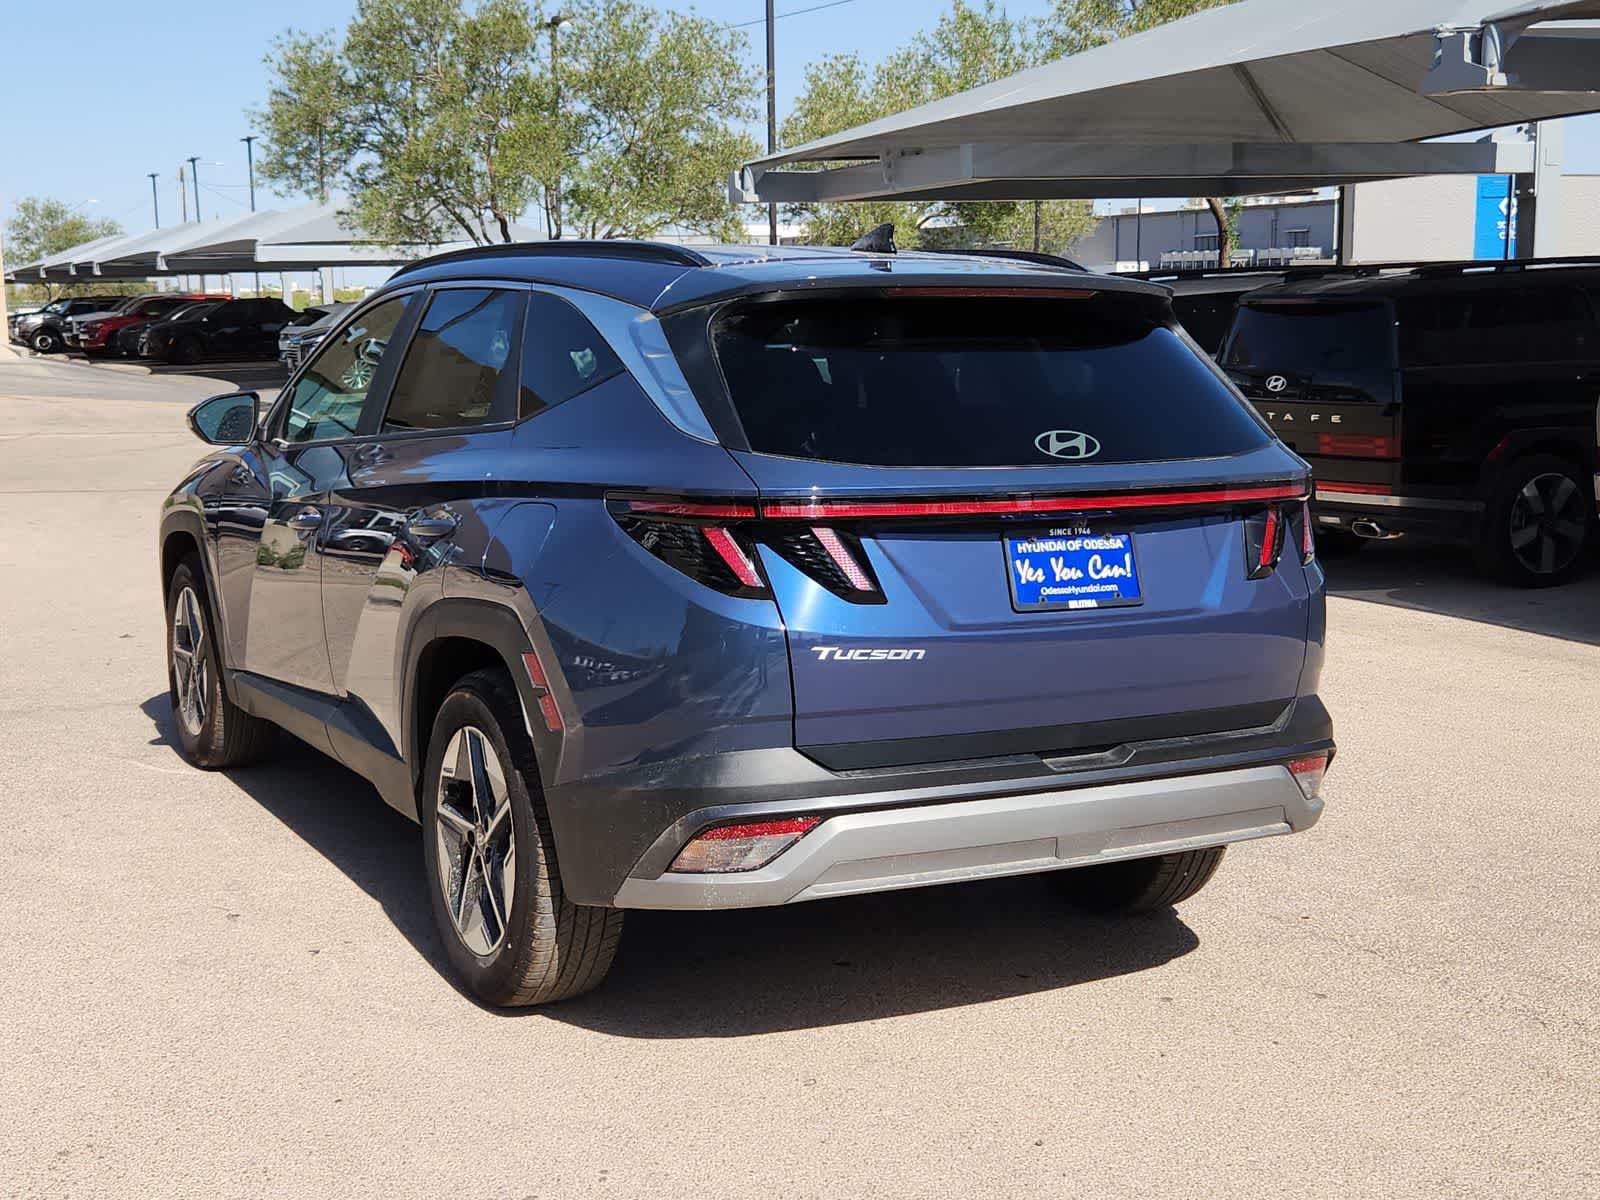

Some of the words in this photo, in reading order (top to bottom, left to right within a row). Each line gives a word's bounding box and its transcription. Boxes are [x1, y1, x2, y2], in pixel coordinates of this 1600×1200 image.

[1310, 414, 1342, 423] FE
[1049, 528, 1072, 536] SINCE
[1074, 527, 1091, 535] 1946
[1017, 541, 1066, 554] HYUNDAI
[1067, 540, 1082, 550] OF
[1083, 538, 1124, 550] ODESSA
[1015, 558, 1045, 584] Yes
[1050, 556, 1084, 582] You
[1088, 552, 1132, 580] Can!
[1040, 584, 1118, 596] OdessaHyundai.com
